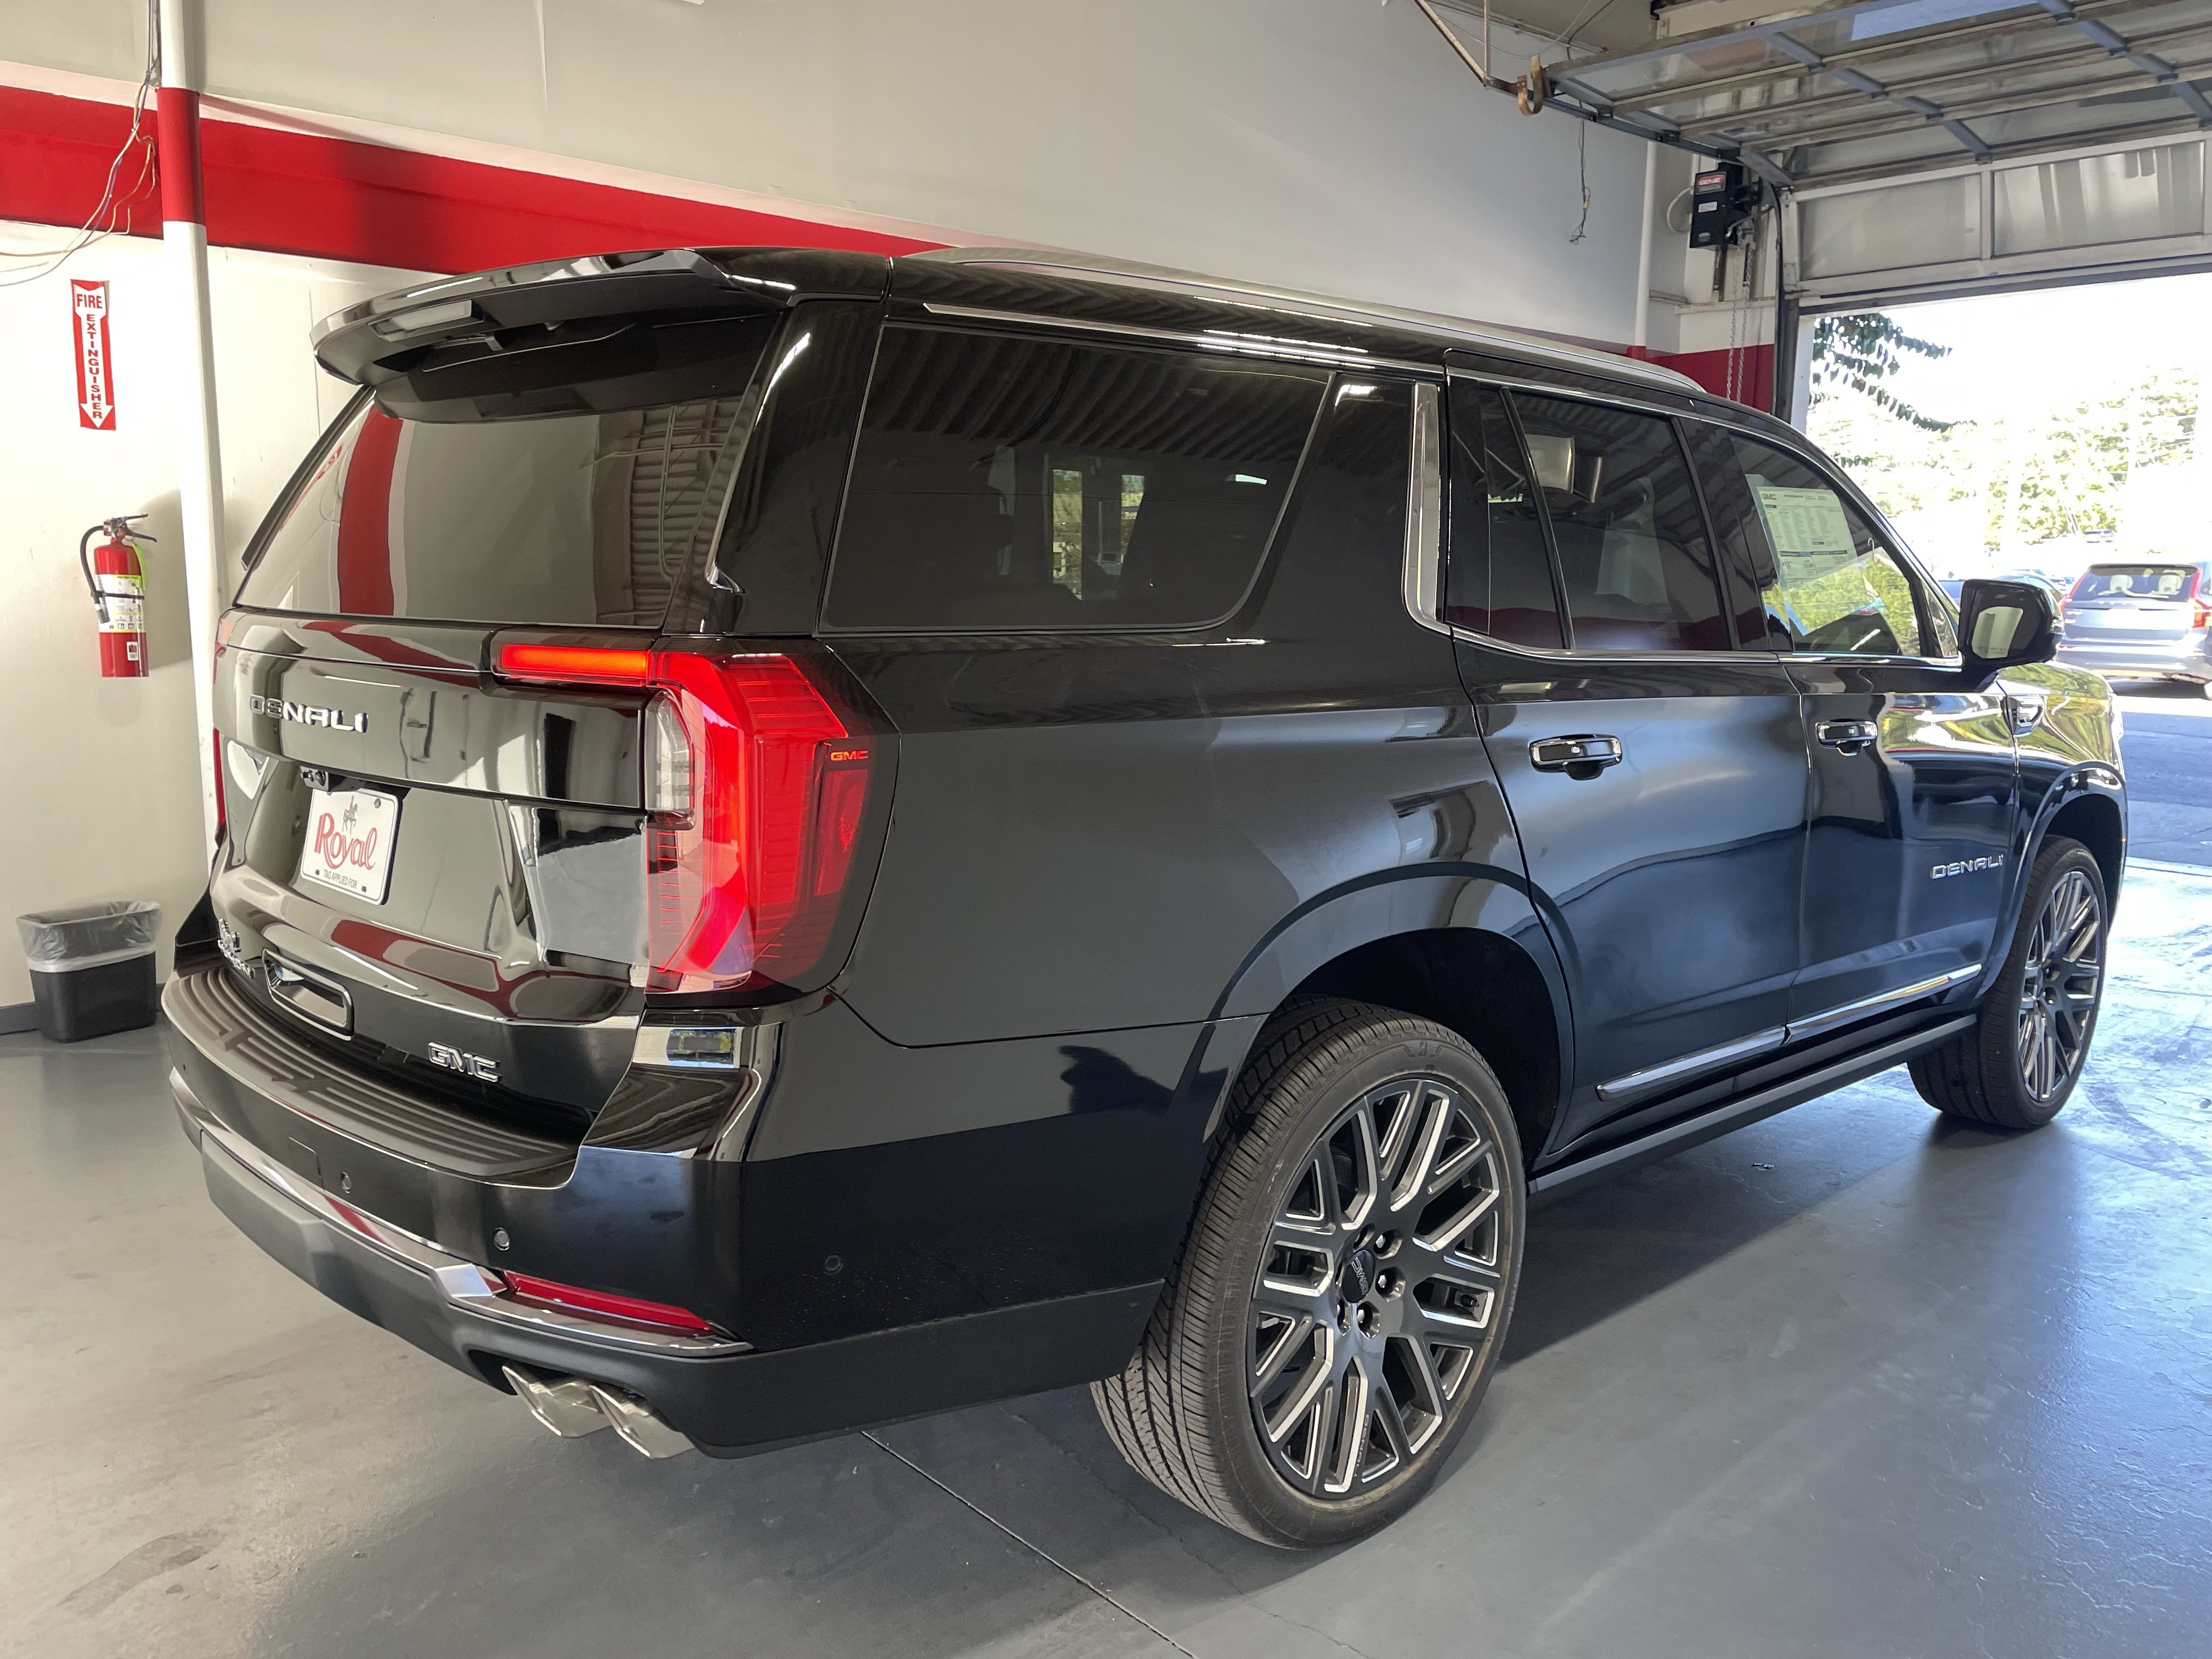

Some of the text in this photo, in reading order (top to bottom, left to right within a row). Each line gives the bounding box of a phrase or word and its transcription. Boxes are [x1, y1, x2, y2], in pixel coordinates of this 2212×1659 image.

[77, 294, 103, 309] FIRE
[86, 314, 103, 419] EXTINGUISHER
[250, 693, 368, 733] DENALI
[830, 750, 868, 761] GMC
[314, 812, 377, 870] Royal
[331, 872, 348, 885] APPLIED
[348, 878, 358, 889] FOR
[1930, 854, 2004, 879] DENALI
[428, 1041, 501, 1082] GMC
[1351, 1257, 1369, 1295] GMC
